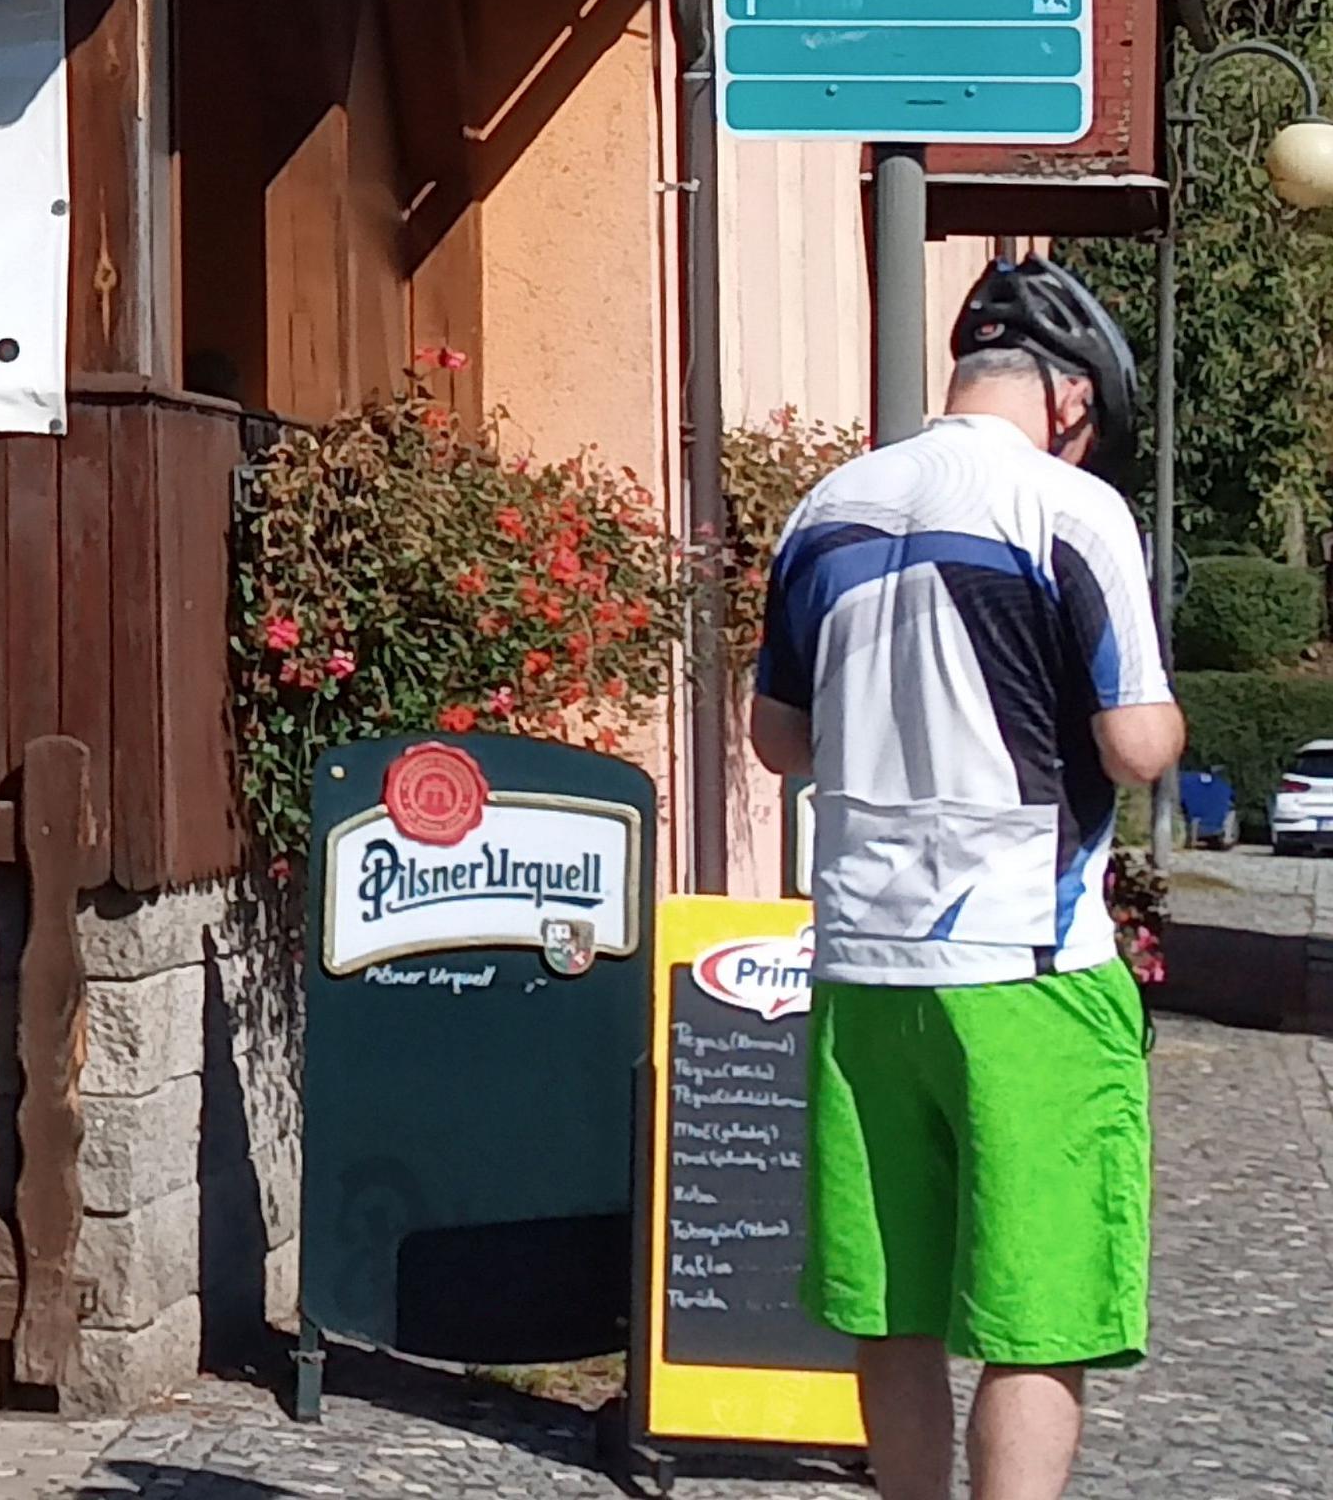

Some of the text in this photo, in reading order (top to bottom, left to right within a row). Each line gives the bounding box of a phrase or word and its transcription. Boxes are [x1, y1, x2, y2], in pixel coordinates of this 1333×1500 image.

[358, 838, 603, 923] Pilsner Urquell
[427, 964, 497, 995] Urquell
[734, 956, 814, 989] Prim
